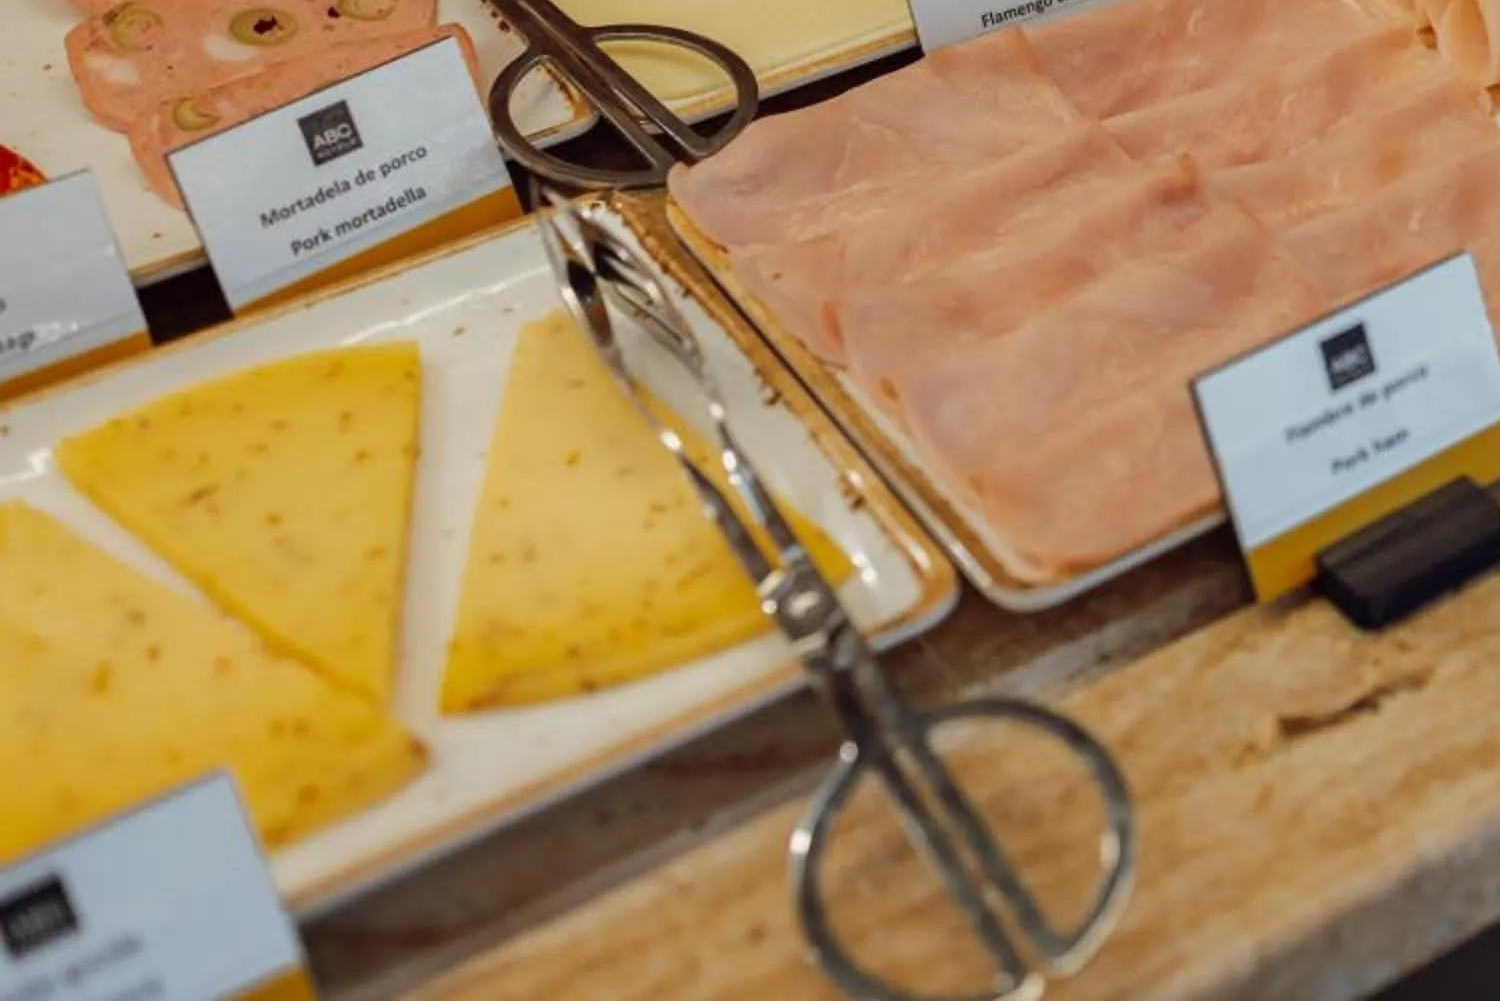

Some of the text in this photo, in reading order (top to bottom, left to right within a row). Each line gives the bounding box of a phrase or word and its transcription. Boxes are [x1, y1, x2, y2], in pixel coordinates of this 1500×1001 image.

[313, 123, 353, 150] ABC
[259, 146, 427, 229] Mortadela de porco
[290, 184, 426, 257] Pork mortadella
[1331, 429, 1409, 475] Pork ham
